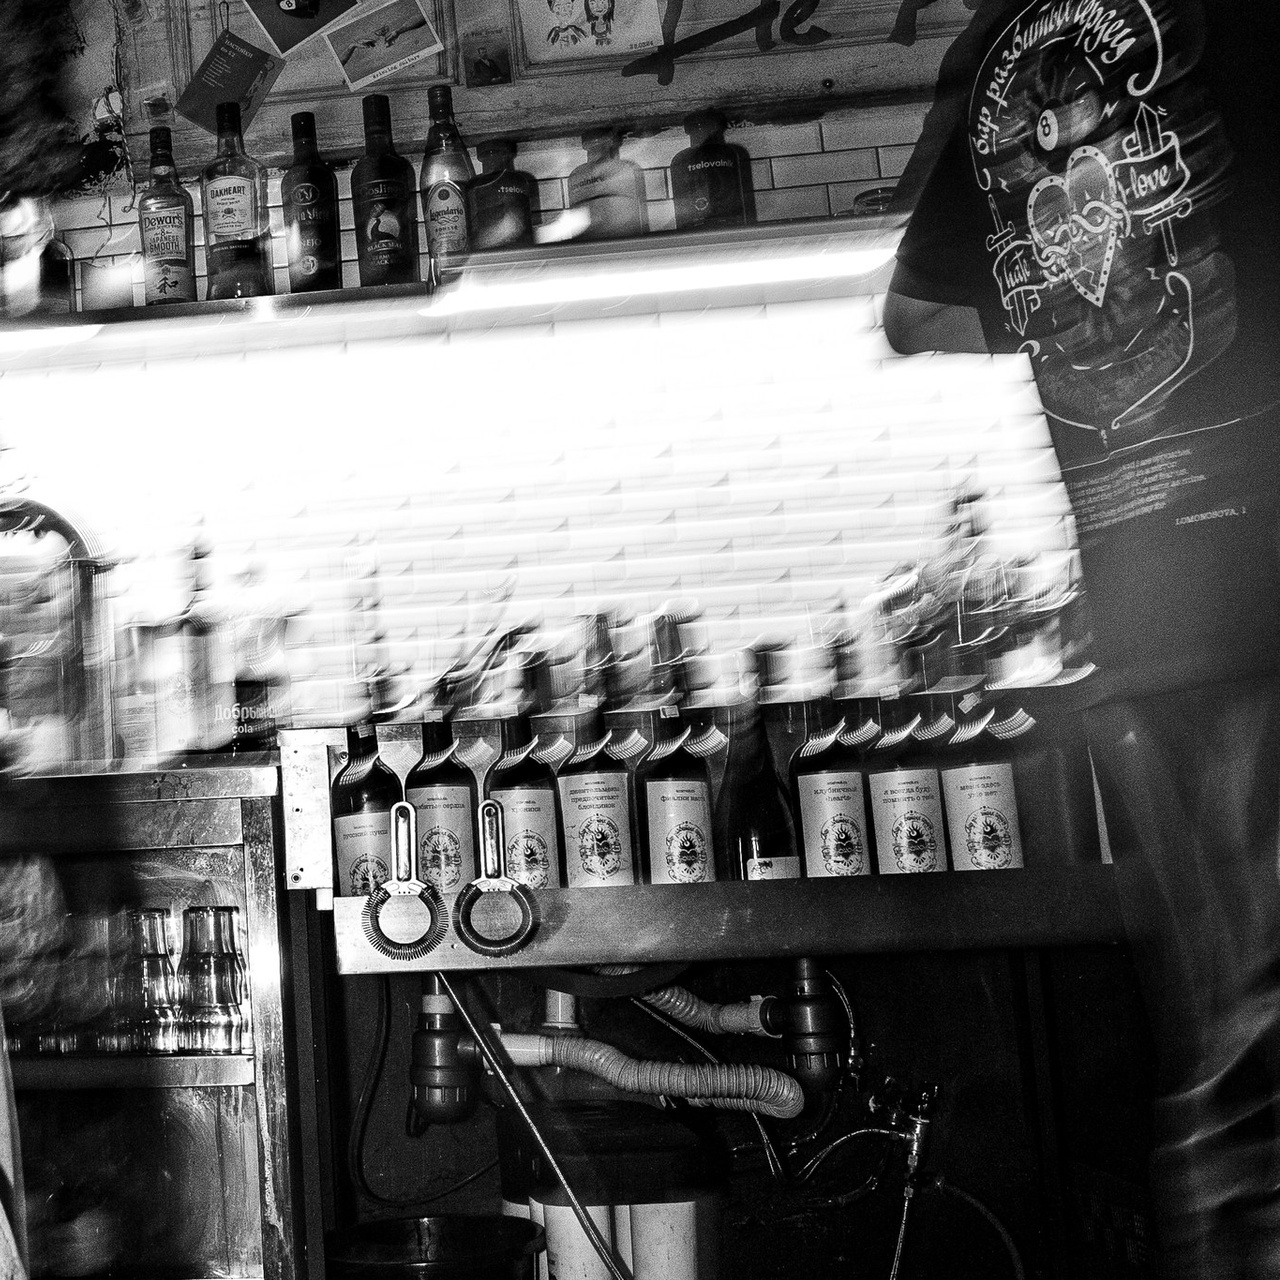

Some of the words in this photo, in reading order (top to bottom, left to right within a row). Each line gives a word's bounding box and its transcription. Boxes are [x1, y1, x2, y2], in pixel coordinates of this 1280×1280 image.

[210, 185, 246, 199] OAKHEART
[144, 213, 184, 230] Dewar's
[149, 240, 180, 254] SMOOTH
[231, 724, 253, 734] cola
